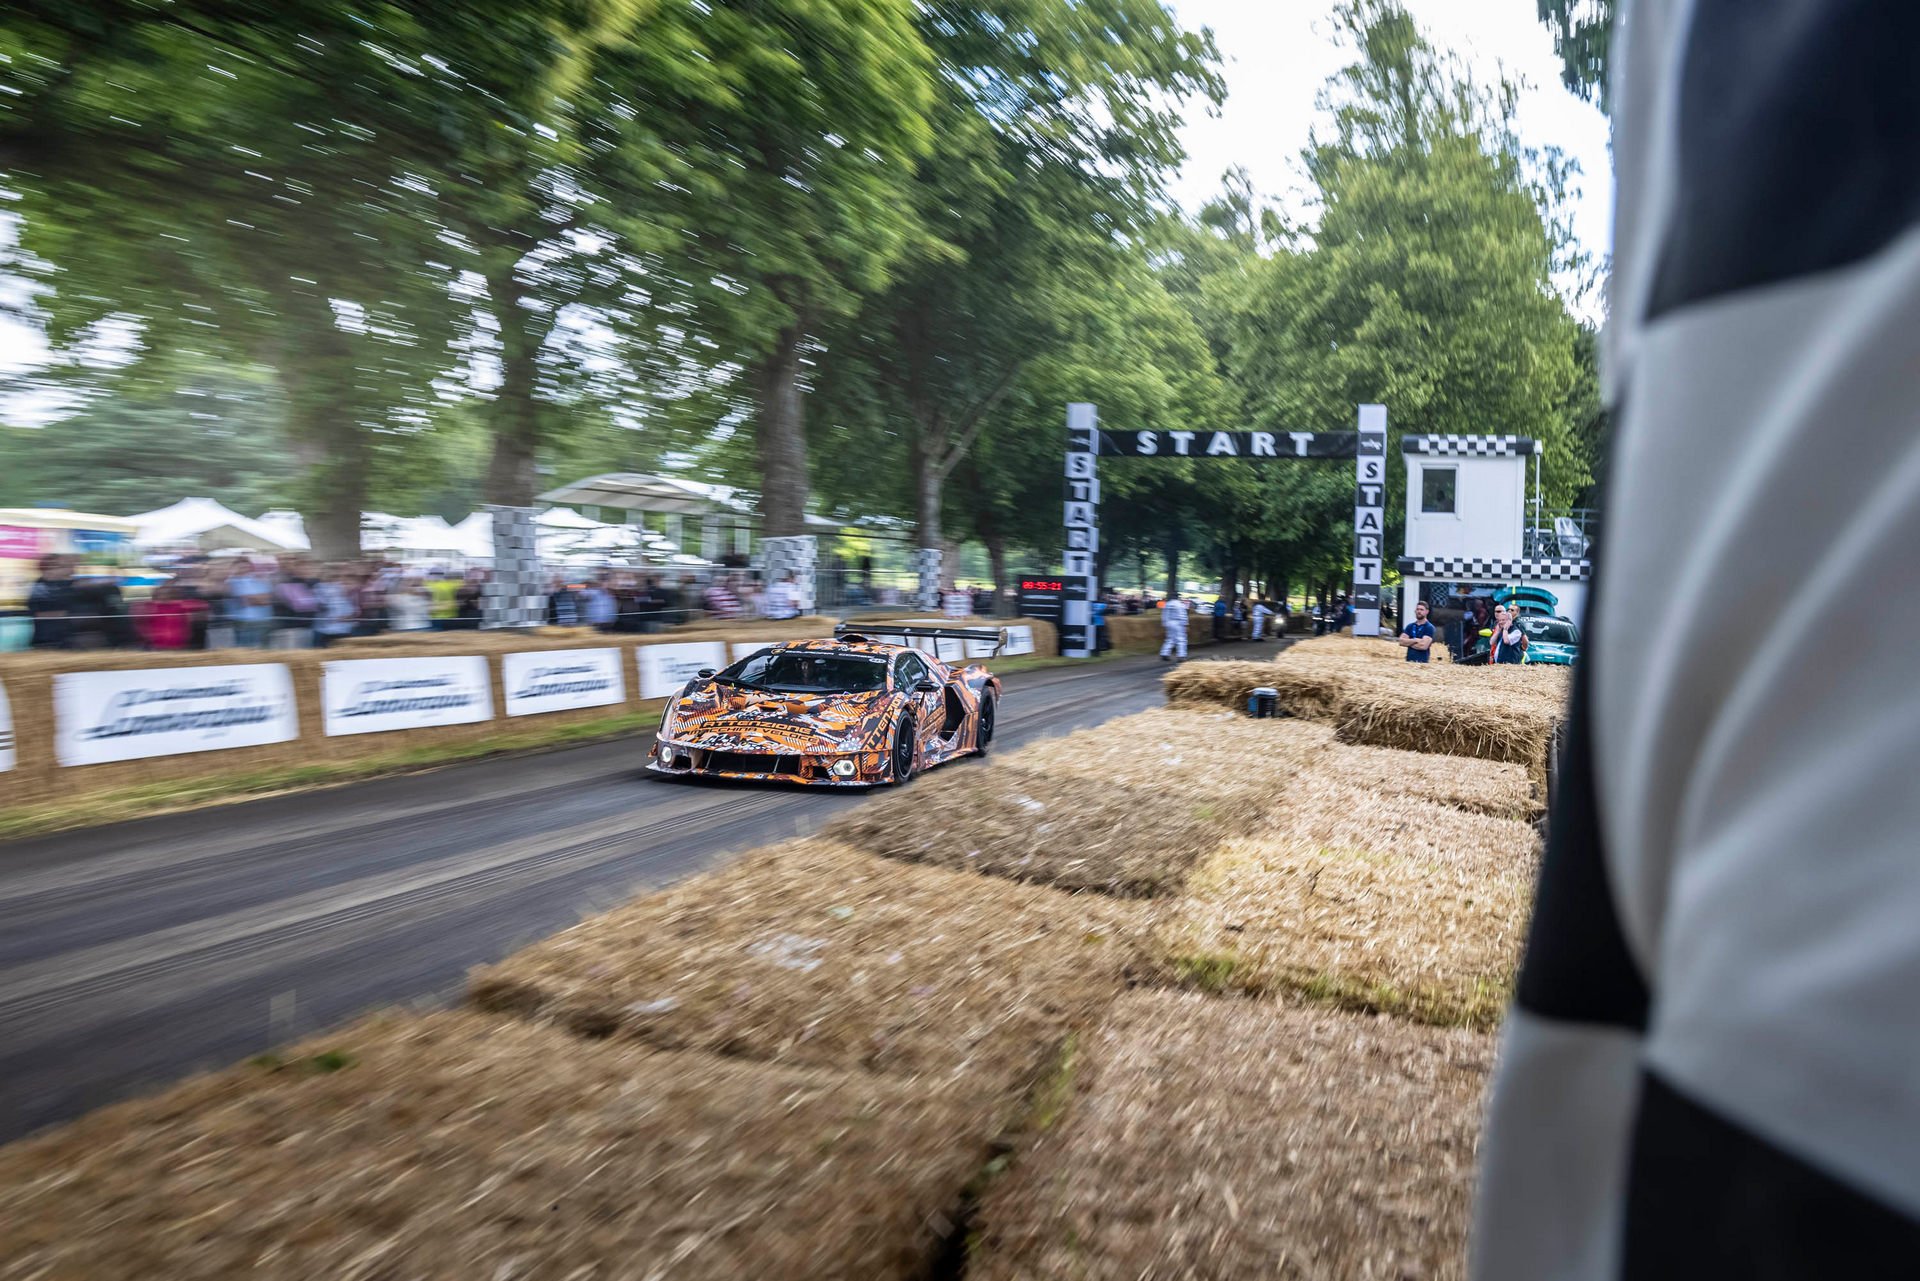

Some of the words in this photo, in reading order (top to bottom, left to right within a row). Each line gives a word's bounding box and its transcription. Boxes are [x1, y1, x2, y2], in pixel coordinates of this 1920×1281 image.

[1136, 430, 1315, 457] START
[1068, 455, 1090, 574] START
[1359, 461, 1382, 581] START
[702, 720, 813, 735] ATTENZIONE
[762, 728, 819, 744] VELOCE
